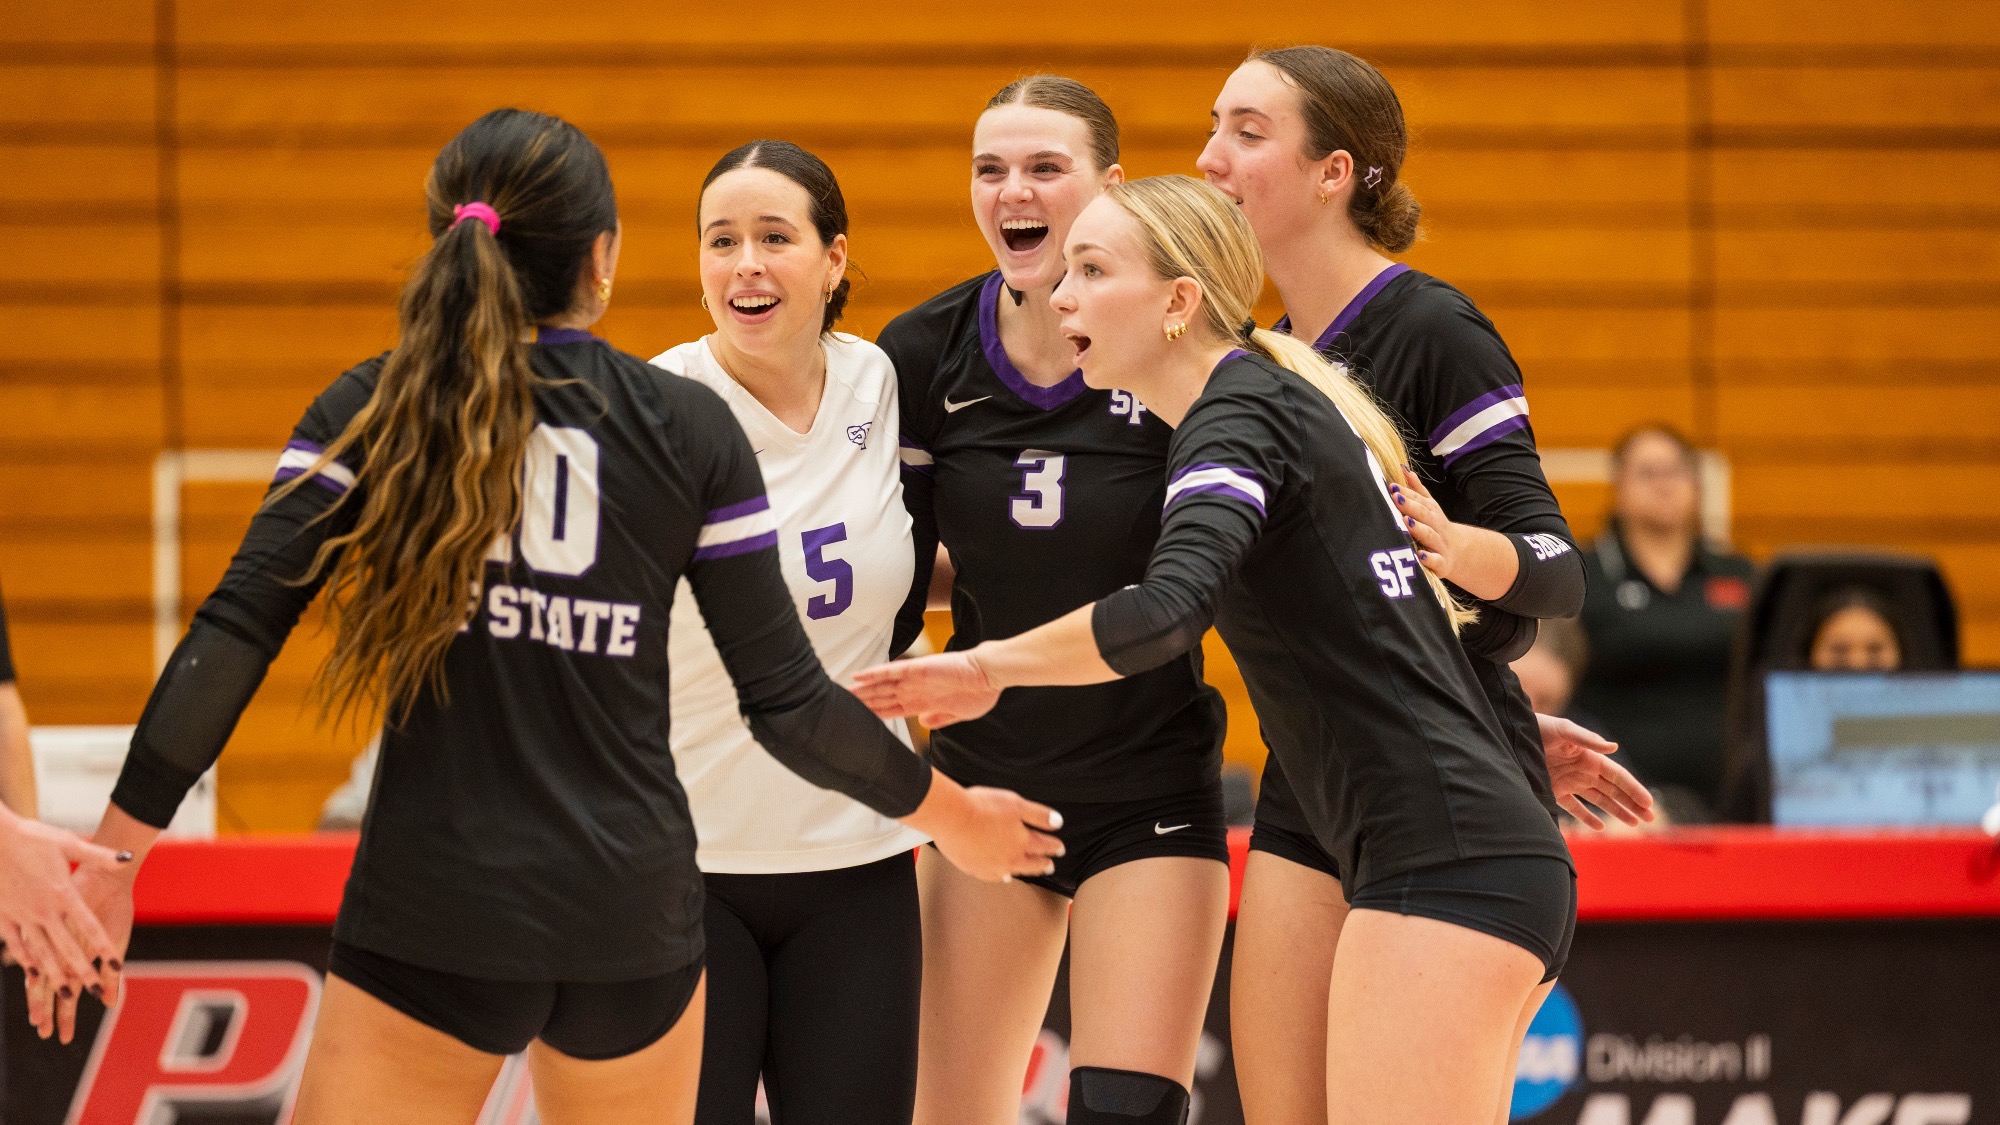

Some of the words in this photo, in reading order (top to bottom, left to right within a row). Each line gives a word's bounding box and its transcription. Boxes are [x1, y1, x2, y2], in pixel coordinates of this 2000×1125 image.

[484, 421, 600, 578] 0
[1008, 449, 1065, 530] 3
[801, 522, 854, 620] 5
[1369, 547, 1416, 598] SF
[487, 582, 642, 658] STATE
